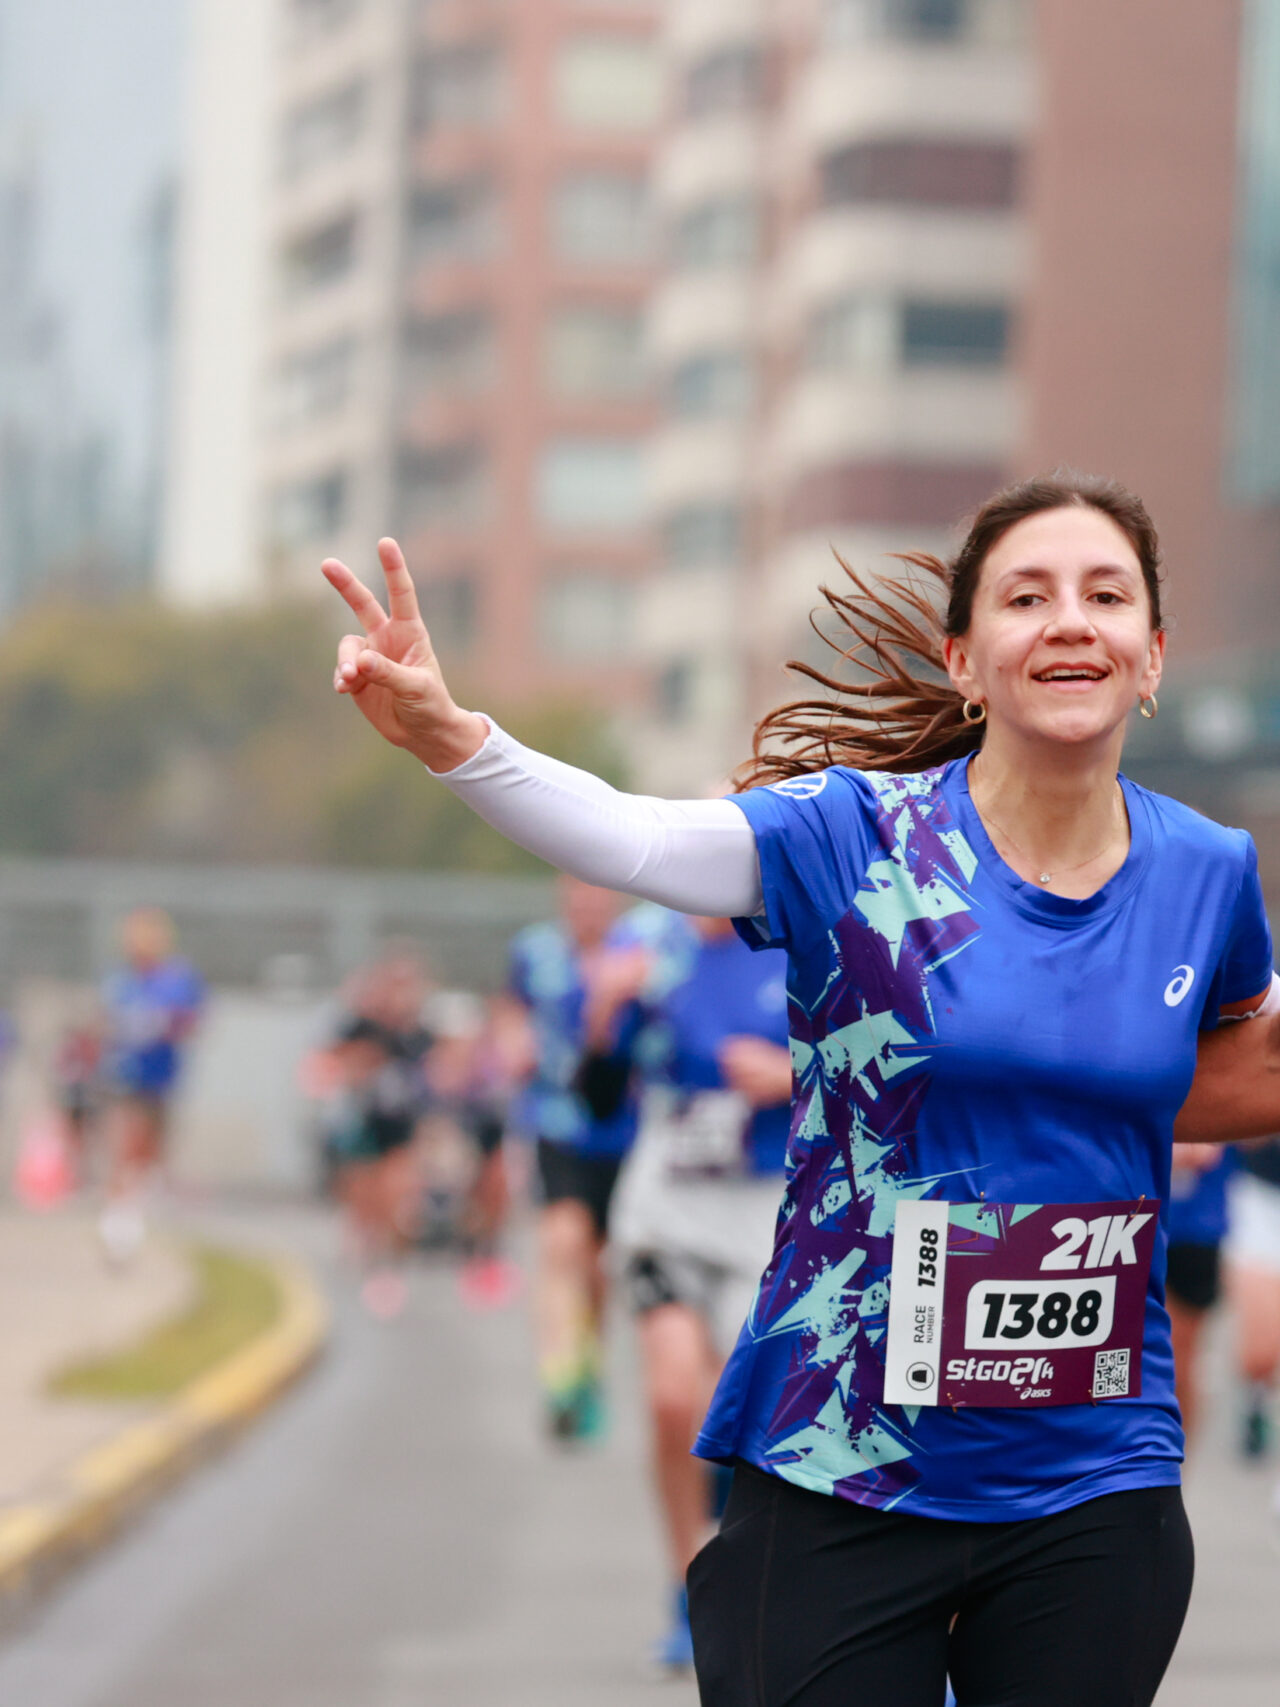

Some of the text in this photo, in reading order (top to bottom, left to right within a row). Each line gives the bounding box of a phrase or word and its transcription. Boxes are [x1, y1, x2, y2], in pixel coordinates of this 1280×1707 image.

[918, 1228, 939, 1287] 1388
[1039, 1213, 1154, 1271] 21K
[914, 1305, 926, 1344] RACE
[926, 1306, 935, 1344] NUMBER
[982, 1290, 1102, 1340] 1388
